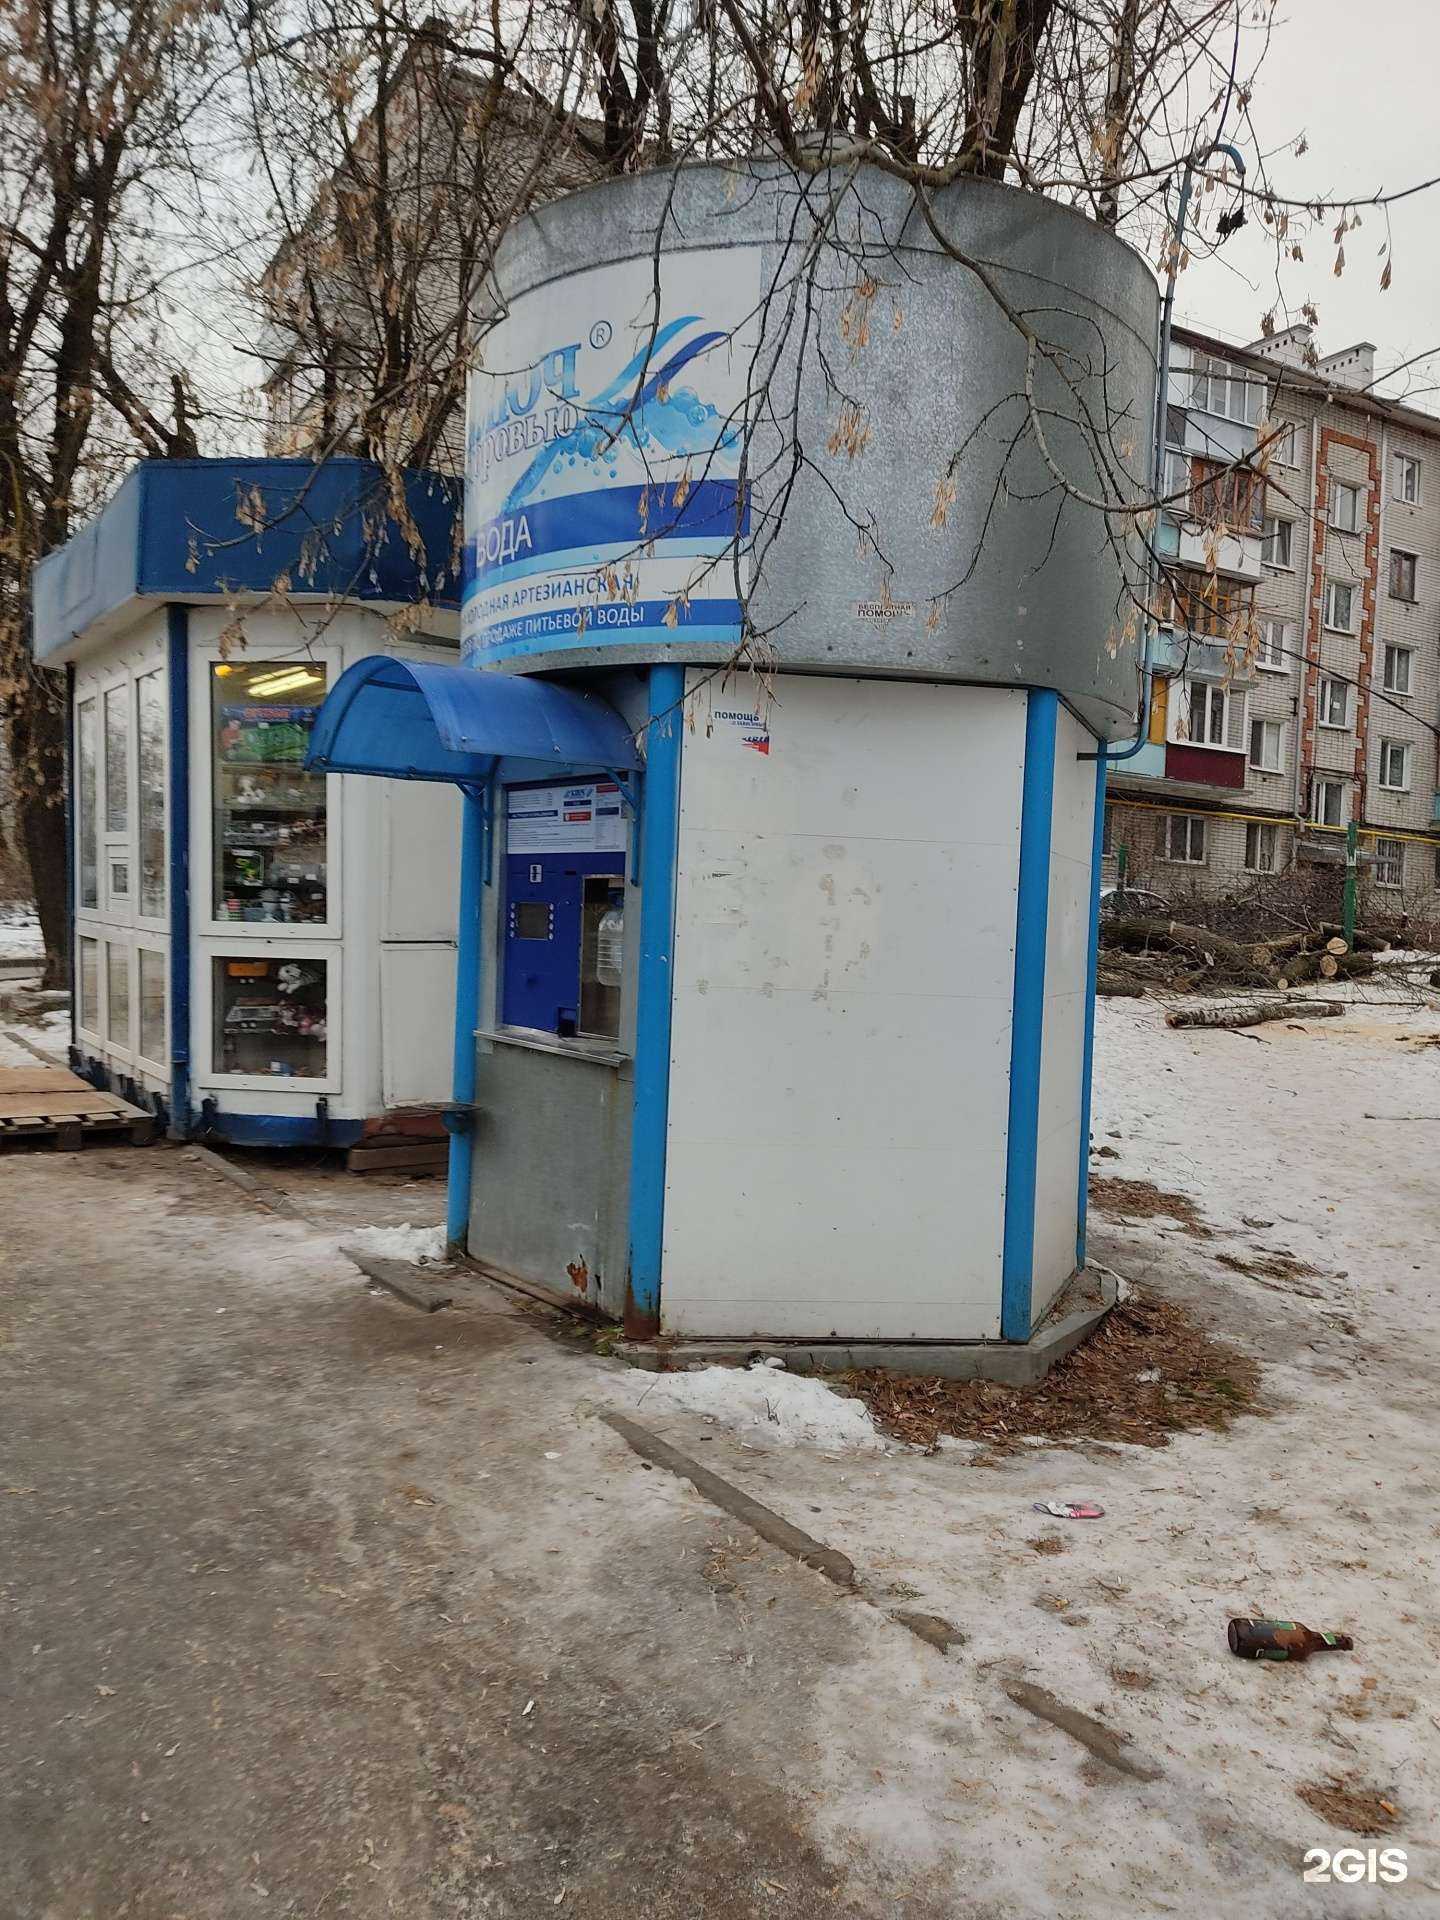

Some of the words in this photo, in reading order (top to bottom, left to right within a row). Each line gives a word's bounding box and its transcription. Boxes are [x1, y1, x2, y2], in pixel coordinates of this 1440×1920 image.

[484, 343, 582, 428] ЮЧ
[476, 515, 533, 568] ВОДА
[525, 607, 593, 635] ПИТЬЕВОЙ
[597, 606, 644, 627] ВОДЫ
